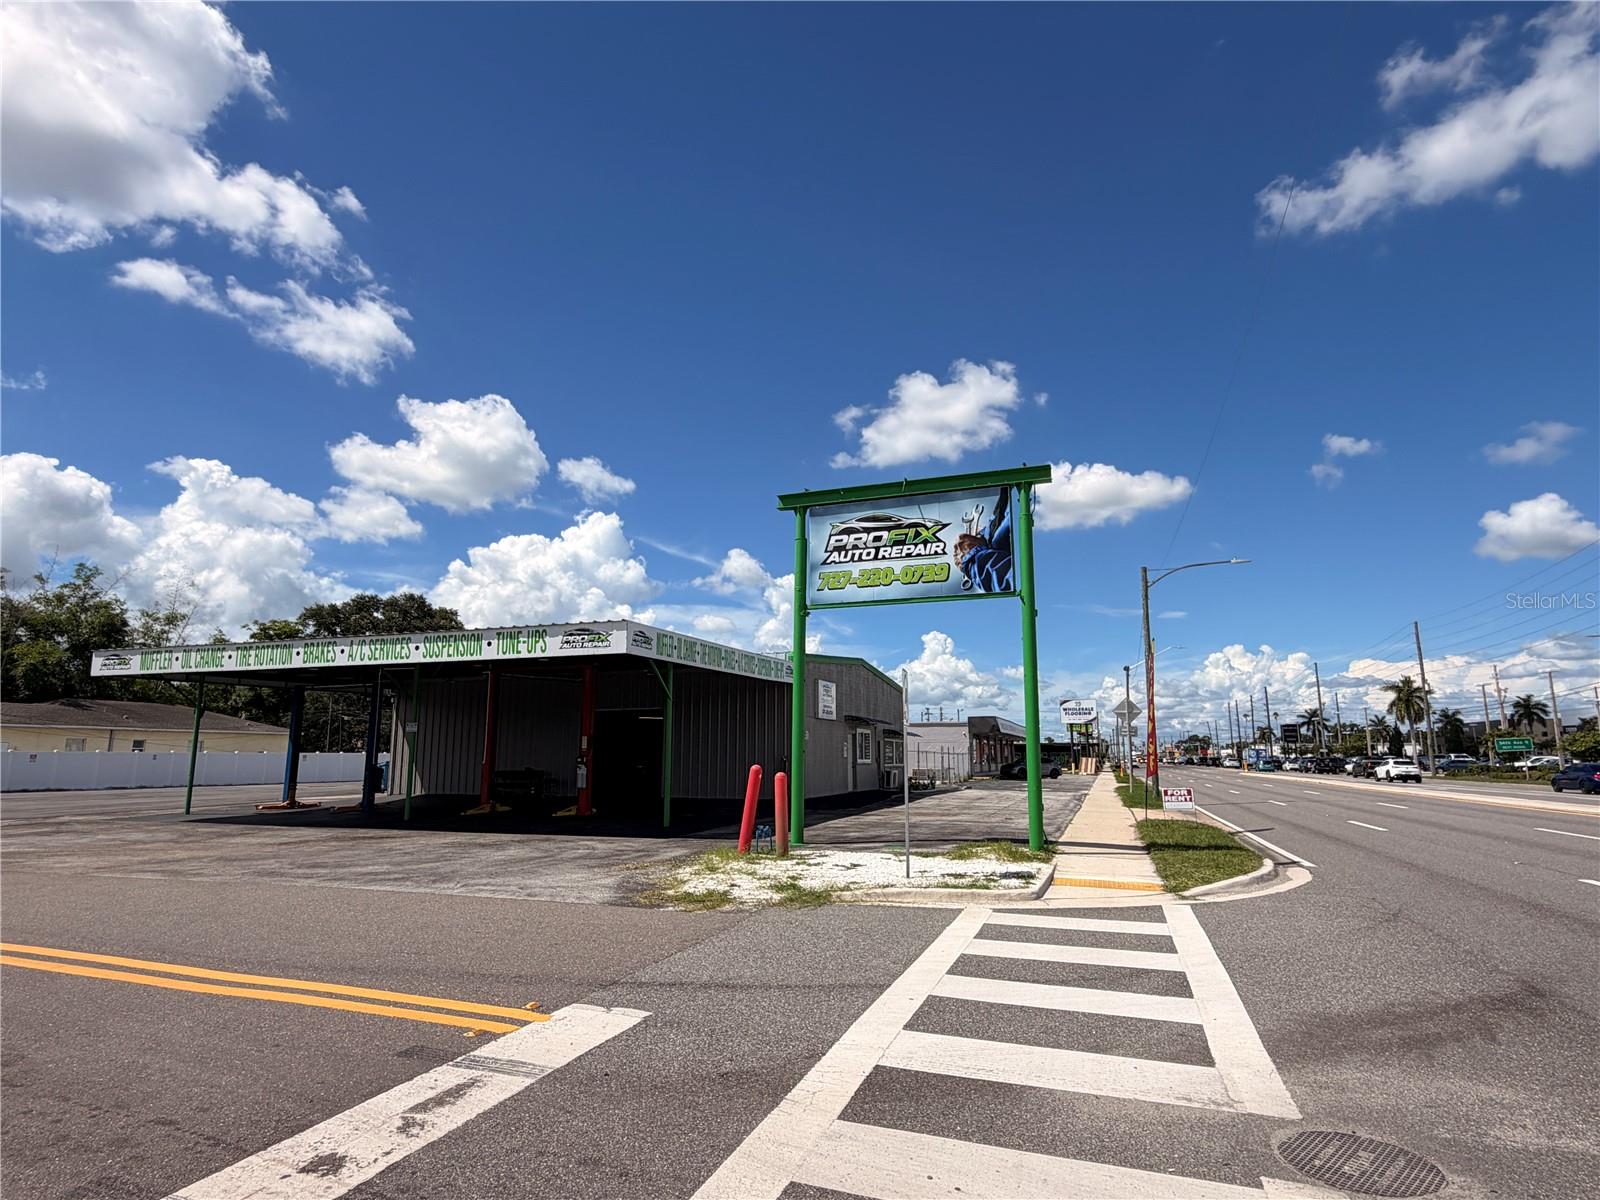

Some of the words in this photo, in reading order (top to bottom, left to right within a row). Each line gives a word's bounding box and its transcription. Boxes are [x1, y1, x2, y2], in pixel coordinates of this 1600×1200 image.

[827, 525, 943, 551] PROFIX
[826, 549, 876, 564] AUTO
[878, 542, 945, 559] REPAIR
[817, 563, 950, 591] 727-220-0739
[139, 650, 173, 671] MUFFLER
[181, 649, 193, 669] OIL
[195, 647, 226, 669] CHANGE
[235, 646, 254, 667] TIRE
[254, 643, 294, 667] ROTATION
[302, 640, 337, 664] BRAKES
[347, 639, 366, 662] A/C
[368, 636, 412, 661] SERVICES
[422, 632, 483, 659] SUSPENSION
[496, 629, 548, 655] TUNE-UPS
[562, 633, 610, 643] PROFIX
